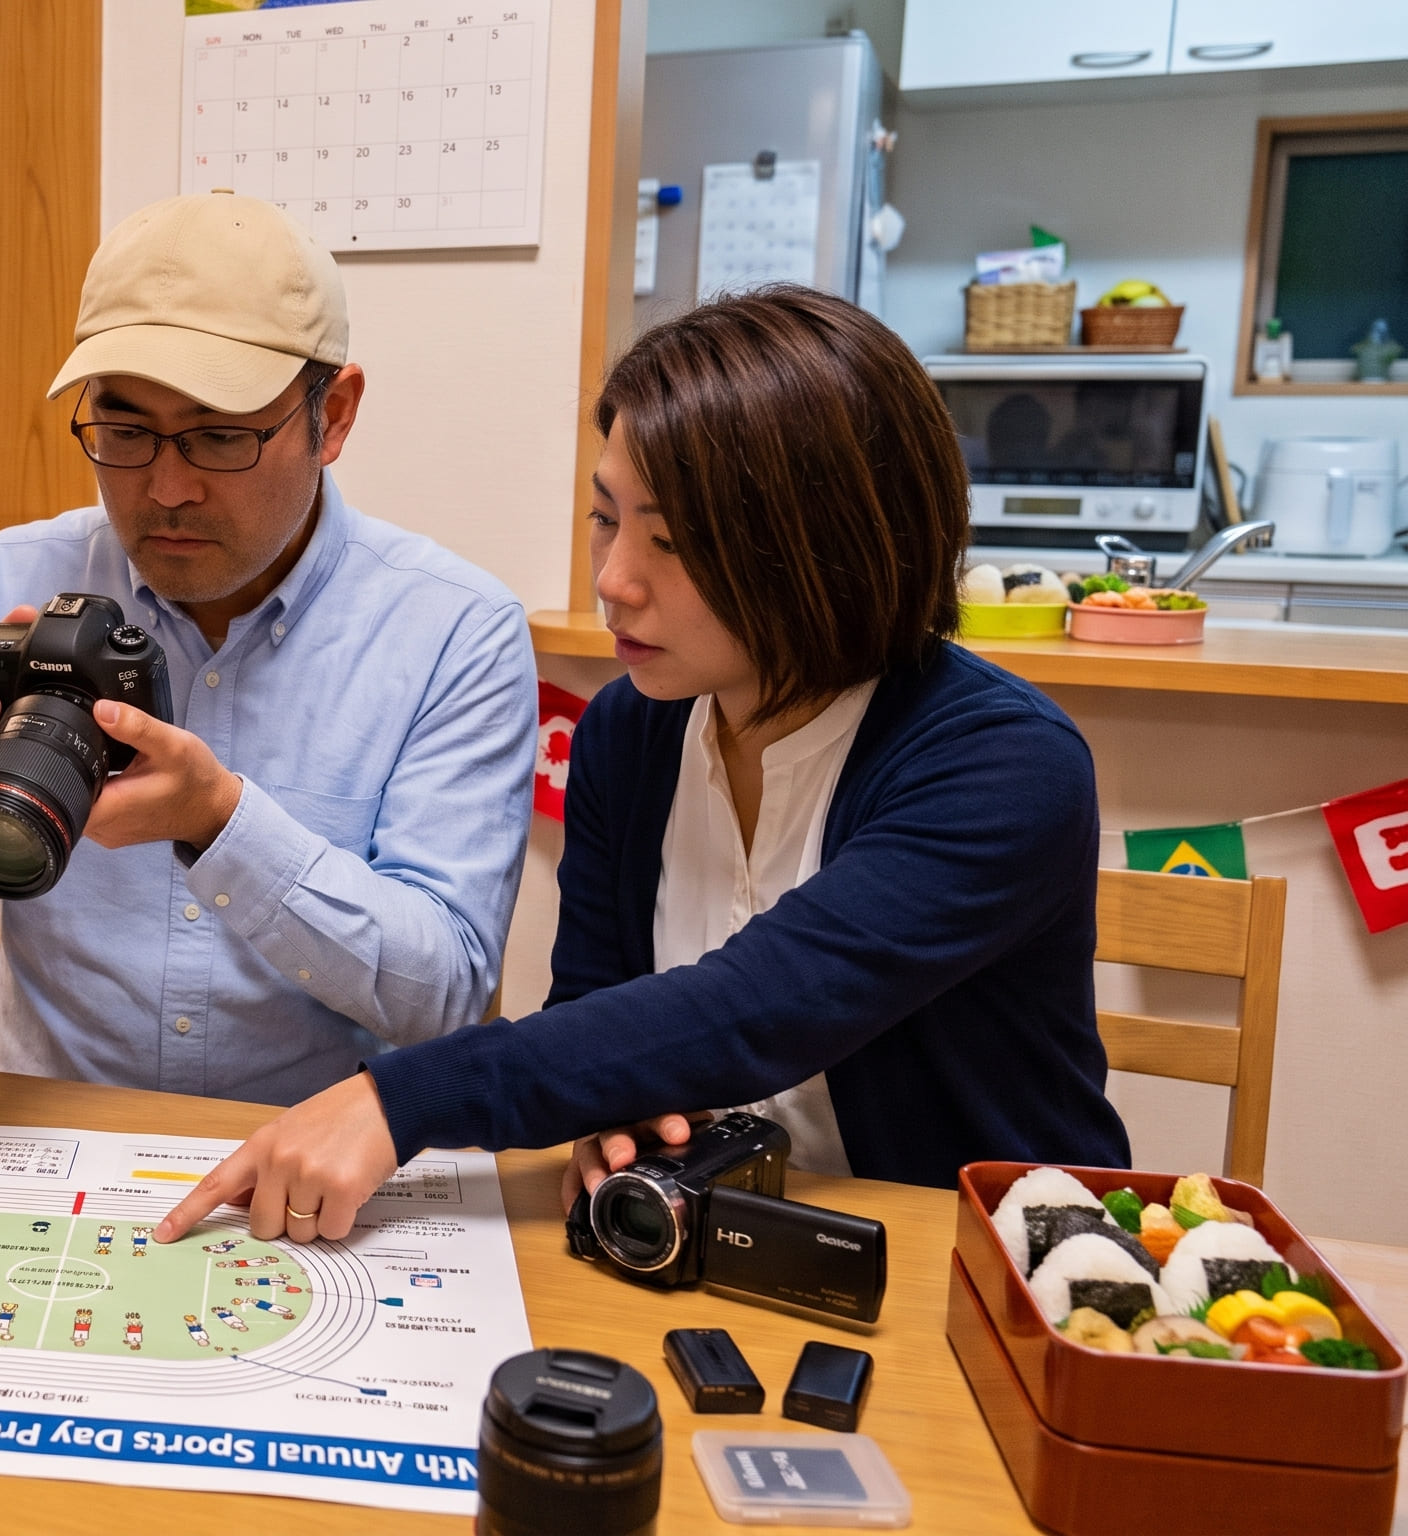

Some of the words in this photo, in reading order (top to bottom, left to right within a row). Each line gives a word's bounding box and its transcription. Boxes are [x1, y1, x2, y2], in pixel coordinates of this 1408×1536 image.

[286, 30, 302, 39] TUE
[325, 26, 344, 36] WED
[369, 24, 387, 32] THU
[457, 16, 473, 25] SAT
[361, 39, 367, 49] 1
[403, 36, 411, 46] 2
[447, 33, 454, 43] 4
[491, 29, 499, 40] 5
[236, 101, 248, 112] 12
[401, 91, 414, 101] 16
[445, 88, 458, 98] 17
[489, 85, 502, 95] 13
[235, 153, 248, 164] 17
[276, 152, 289, 162] 18
[316, 149, 329, 160] 19
[356, 147, 370, 158] 20
[398, 145, 413, 156] 23
[442, 143, 456, 154] 24
[486, 140, 500, 151] 25
[314, 201, 328, 212] 28
[354, 199, 369, 210] 29
[397, 198, 411, 209] 30
[29, 660, 73, 673] Canon
[716, 1227, 754, 1249] HD
[50, 1419, 123, 1453] Day
[133, 1431, 255, 1464] Sports
